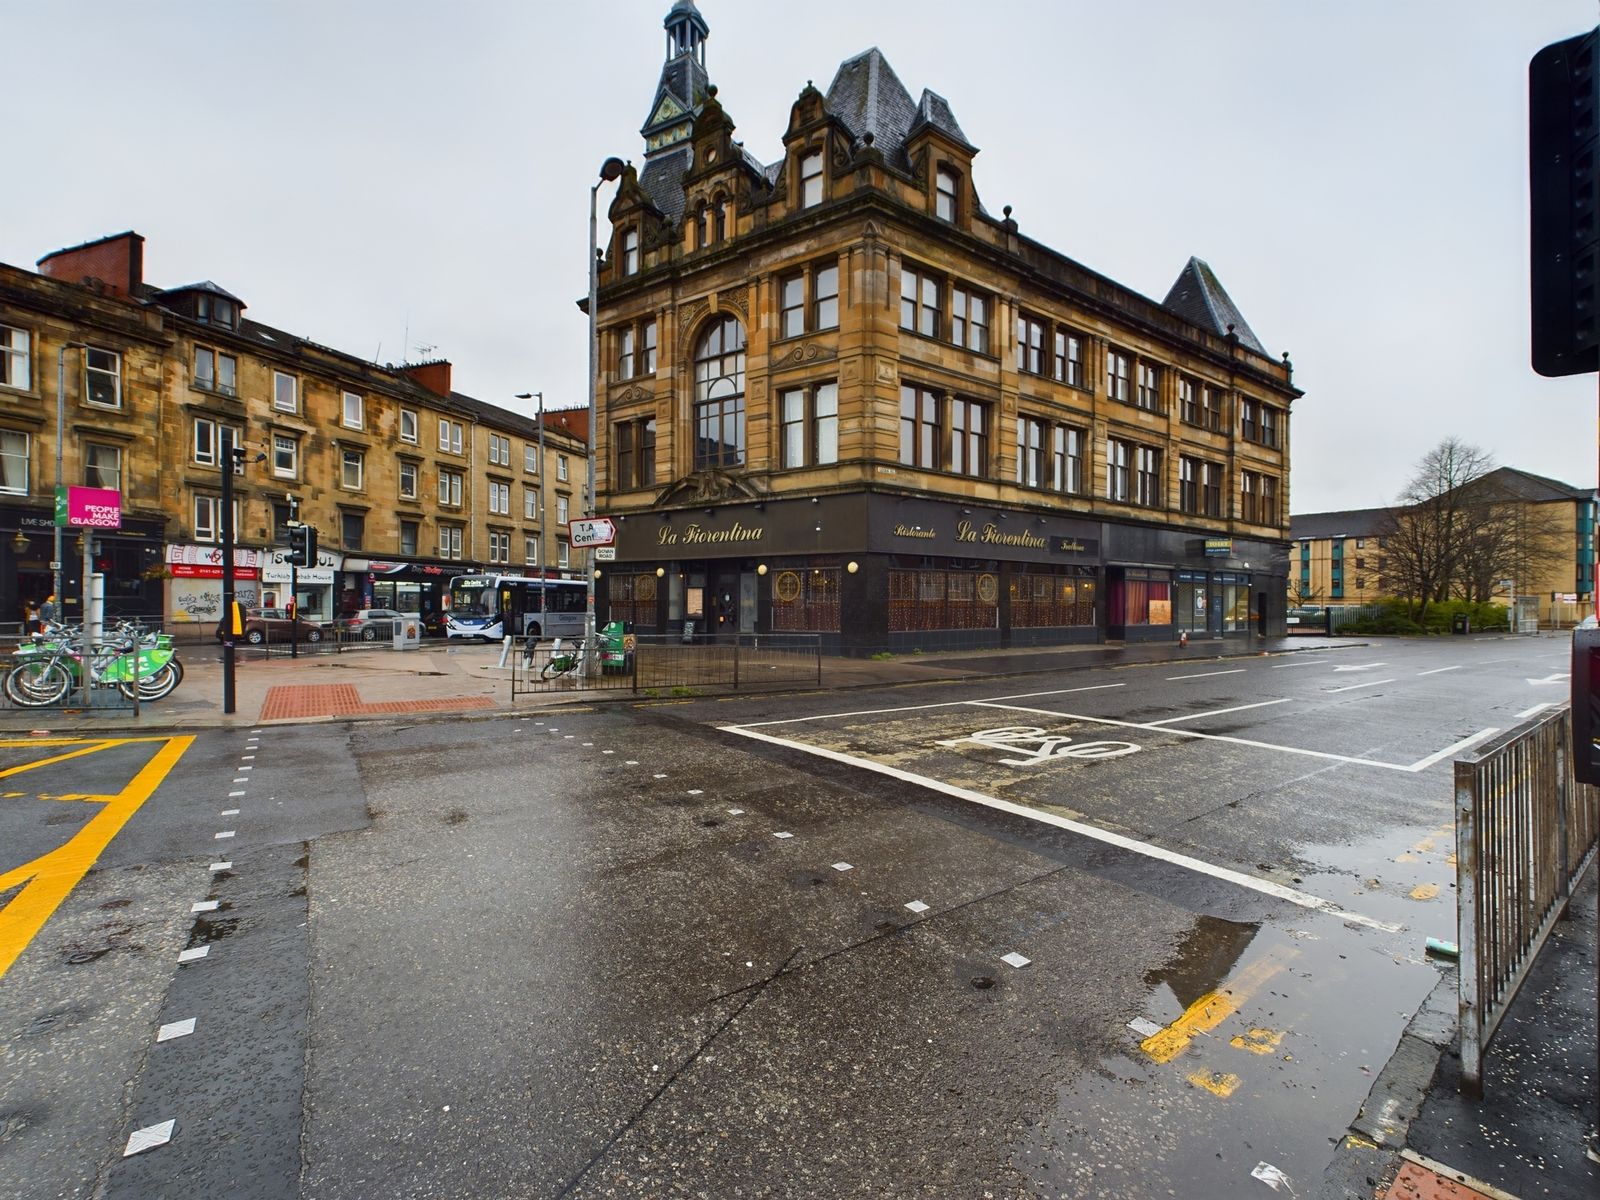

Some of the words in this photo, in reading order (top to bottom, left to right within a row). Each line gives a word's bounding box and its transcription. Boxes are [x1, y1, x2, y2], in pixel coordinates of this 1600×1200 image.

[84, 504, 120, 513] PEOPLE
[70, 516, 120, 526] GLASGOW
[92, 512, 119, 520] MAKE
[38, 519, 55, 527] SHO
[657, 525, 678, 545] La
[682, 522, 763, 544] Fiorentina
[893, 521, 936, 539] Ristorante
[956, 520, 977, 543] La
[981, 522, 1046, 548] Fiorentina
[271, 553, 334, 567] ISUL
